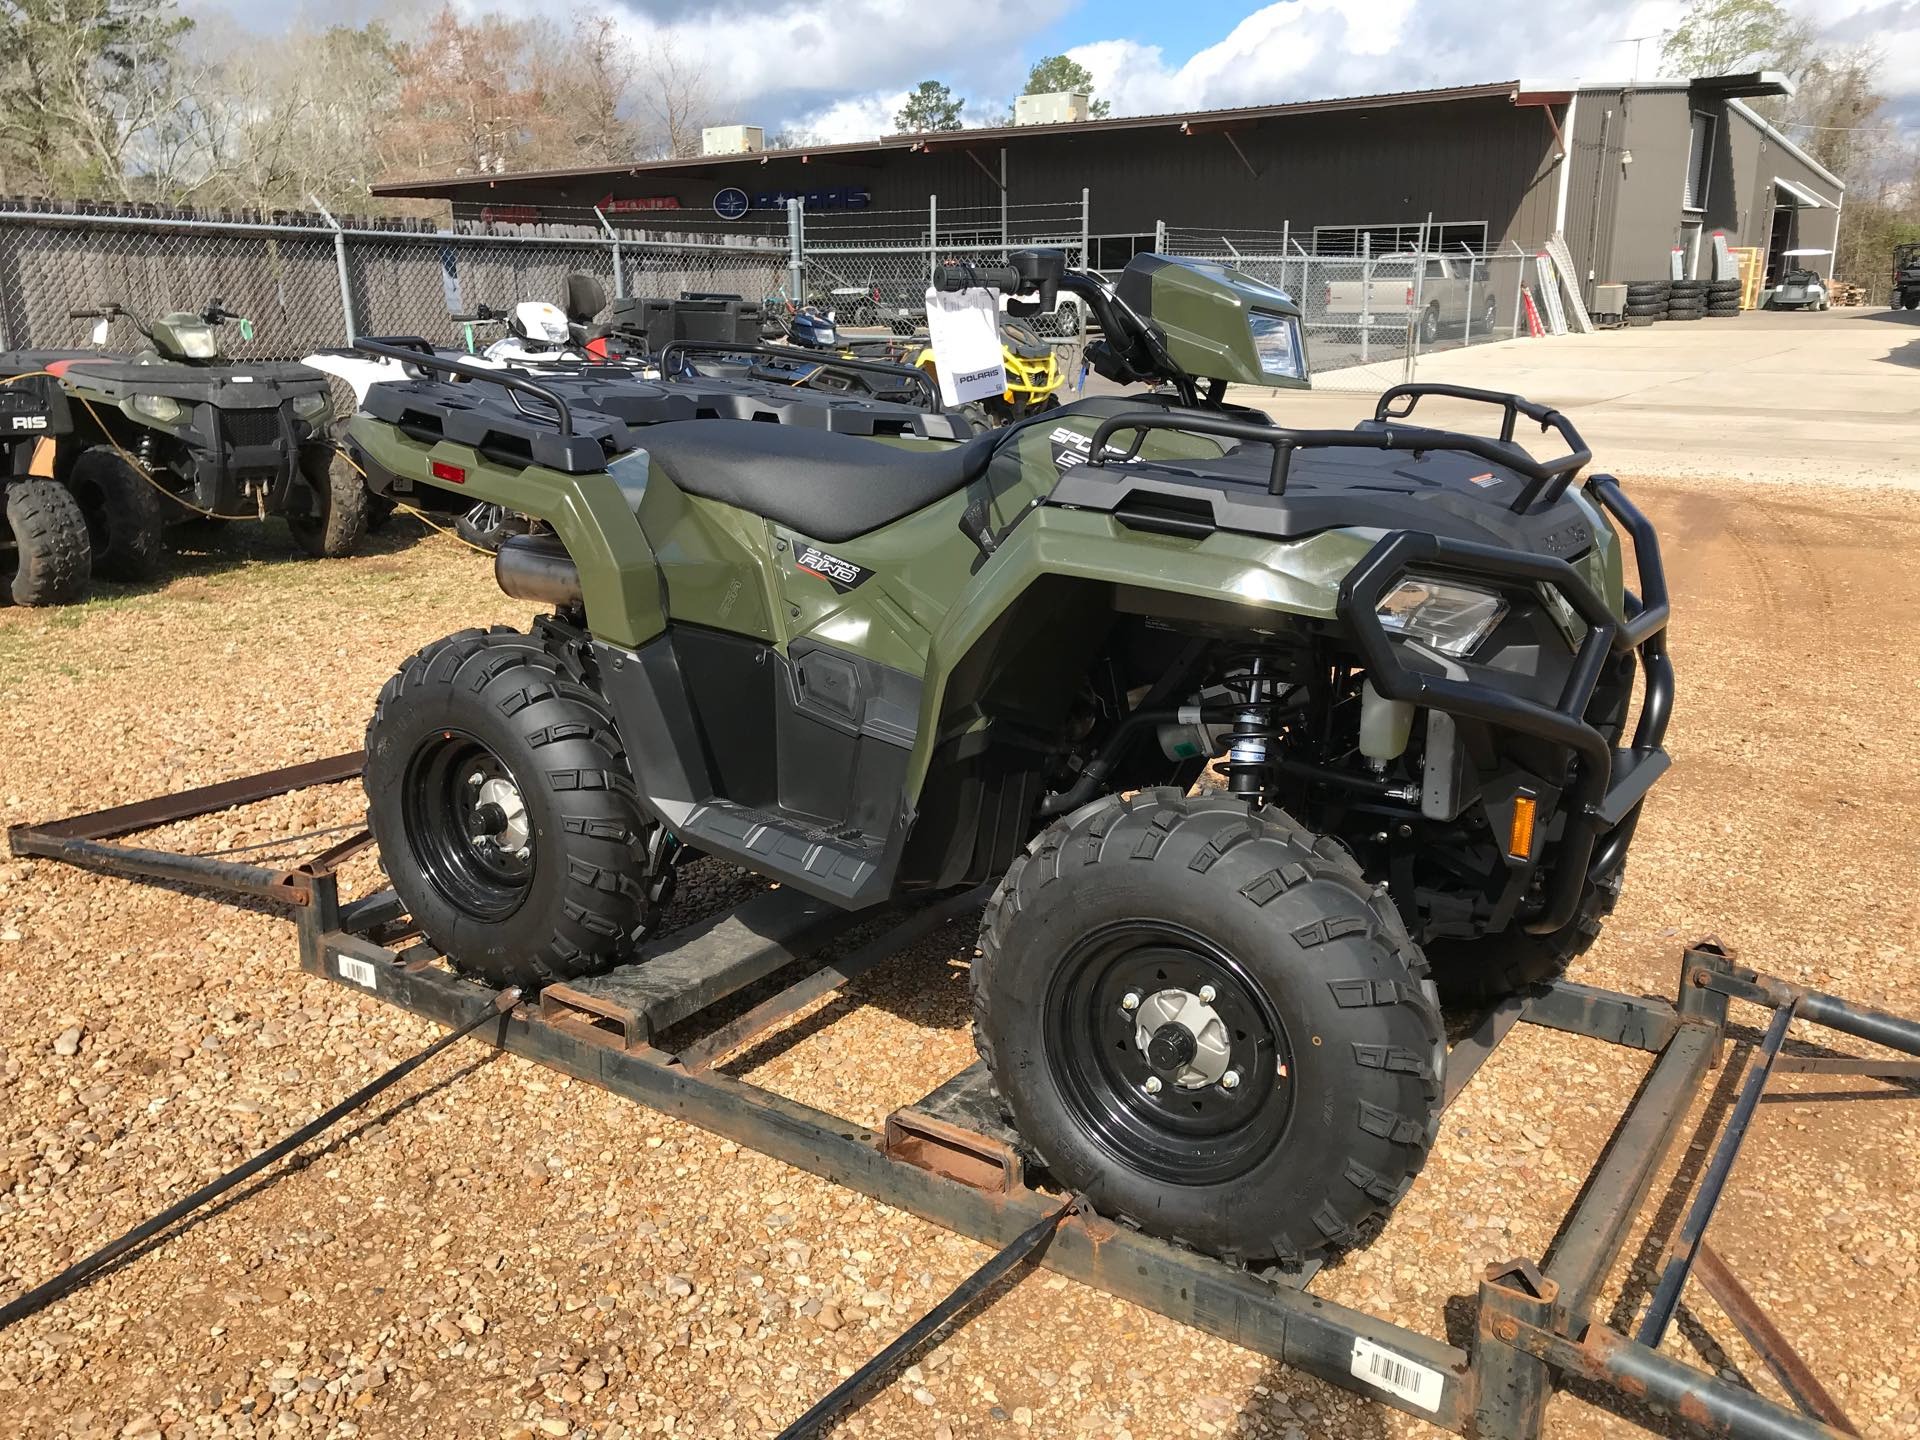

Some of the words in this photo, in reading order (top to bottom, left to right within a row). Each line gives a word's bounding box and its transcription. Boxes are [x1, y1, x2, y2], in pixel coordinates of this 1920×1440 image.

[959, 370, 998, 384] POLARIS
[12, 416, 47, 429] RIS
[798, 552, 857, 583] AWD
[823, 554, 860, 573] DEMAND
